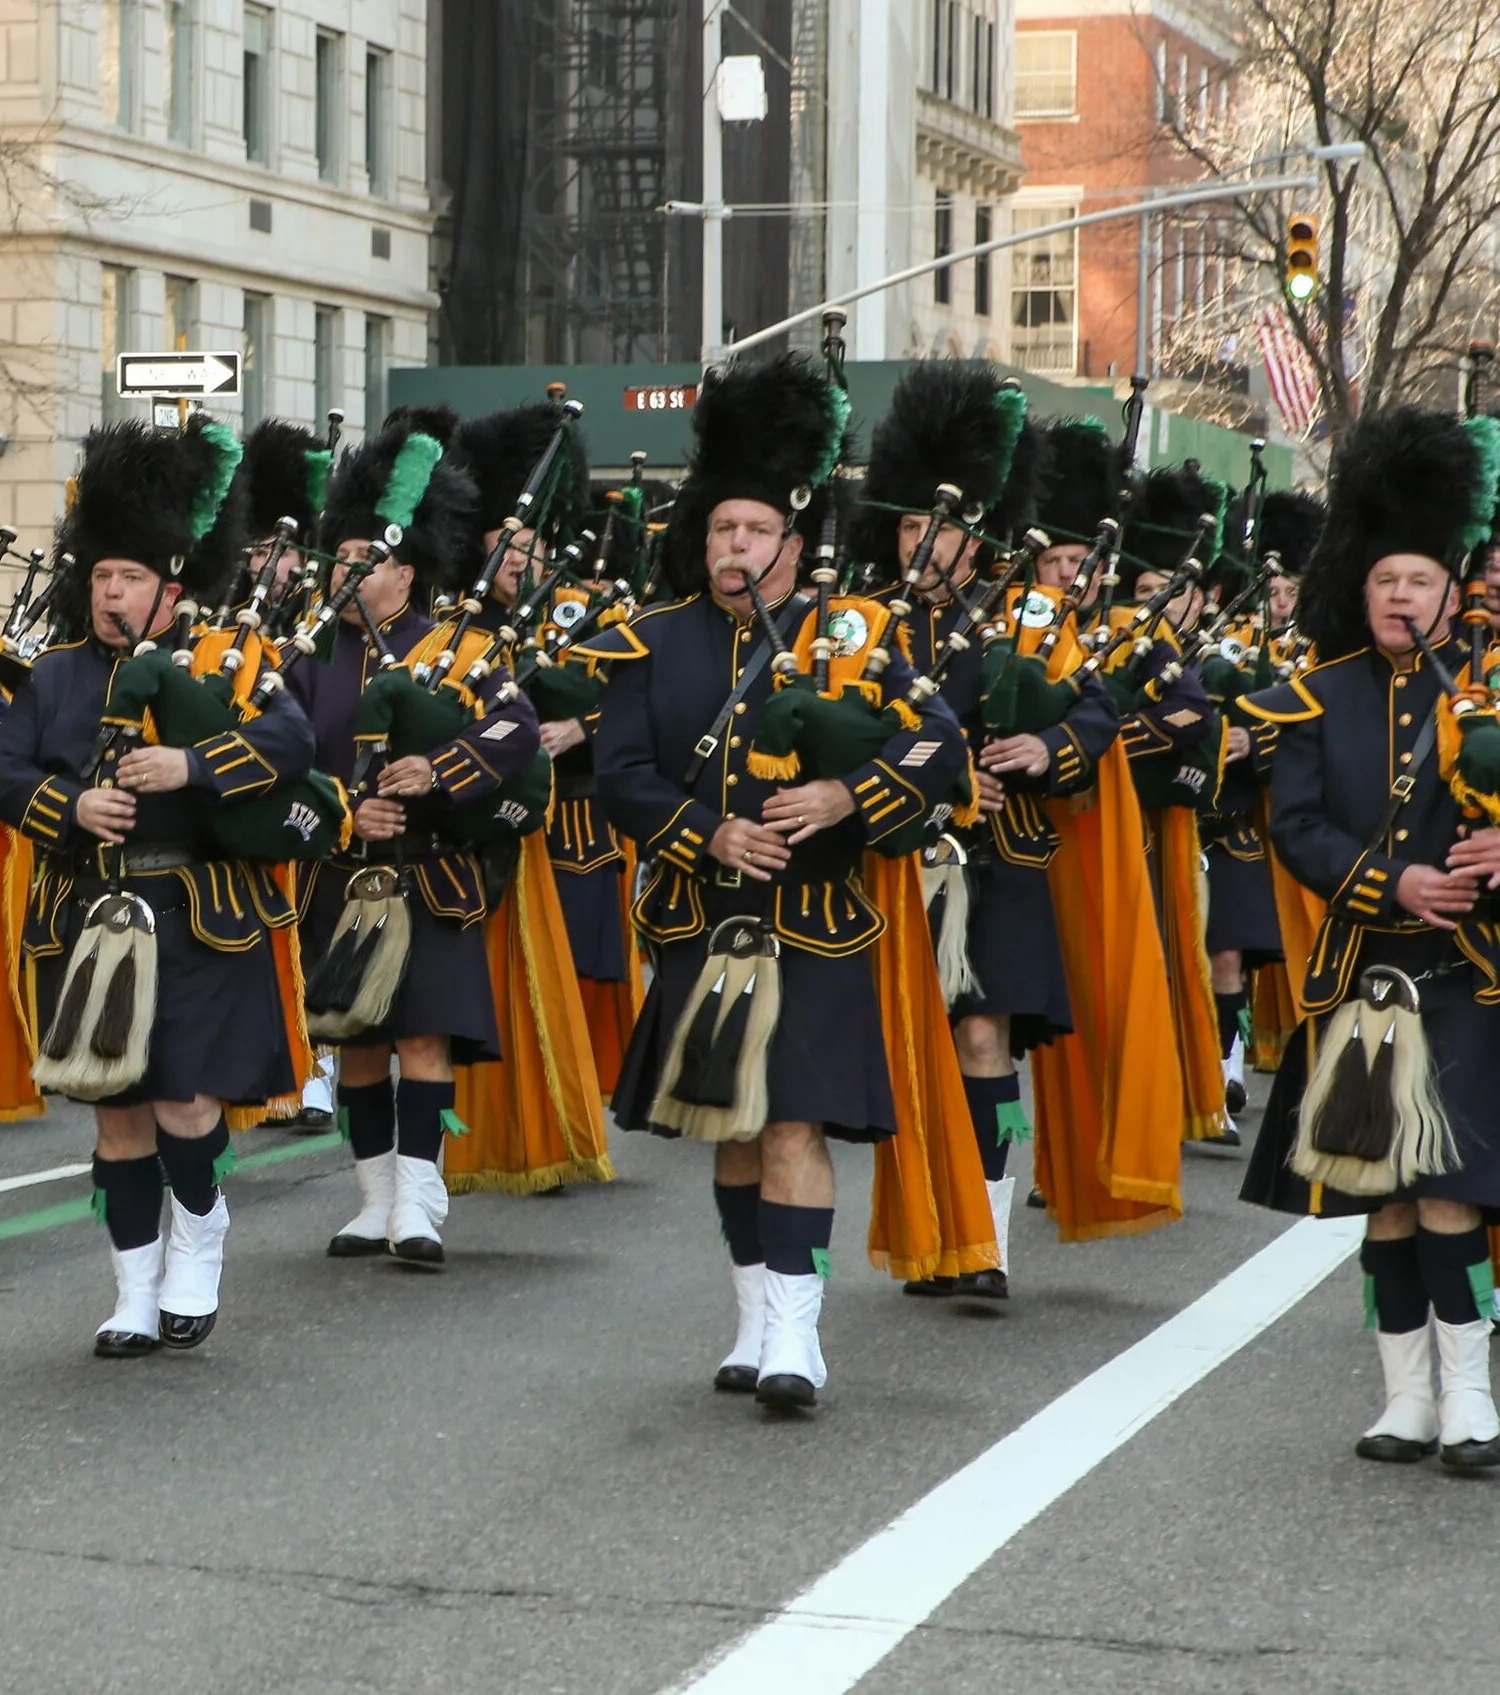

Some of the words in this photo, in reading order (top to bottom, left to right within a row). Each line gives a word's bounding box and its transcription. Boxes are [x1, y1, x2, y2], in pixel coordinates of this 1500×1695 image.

[636, 391, 645, 409] E
[649, 390, 666, 409] 63
[669, 389, 685, 409] St
